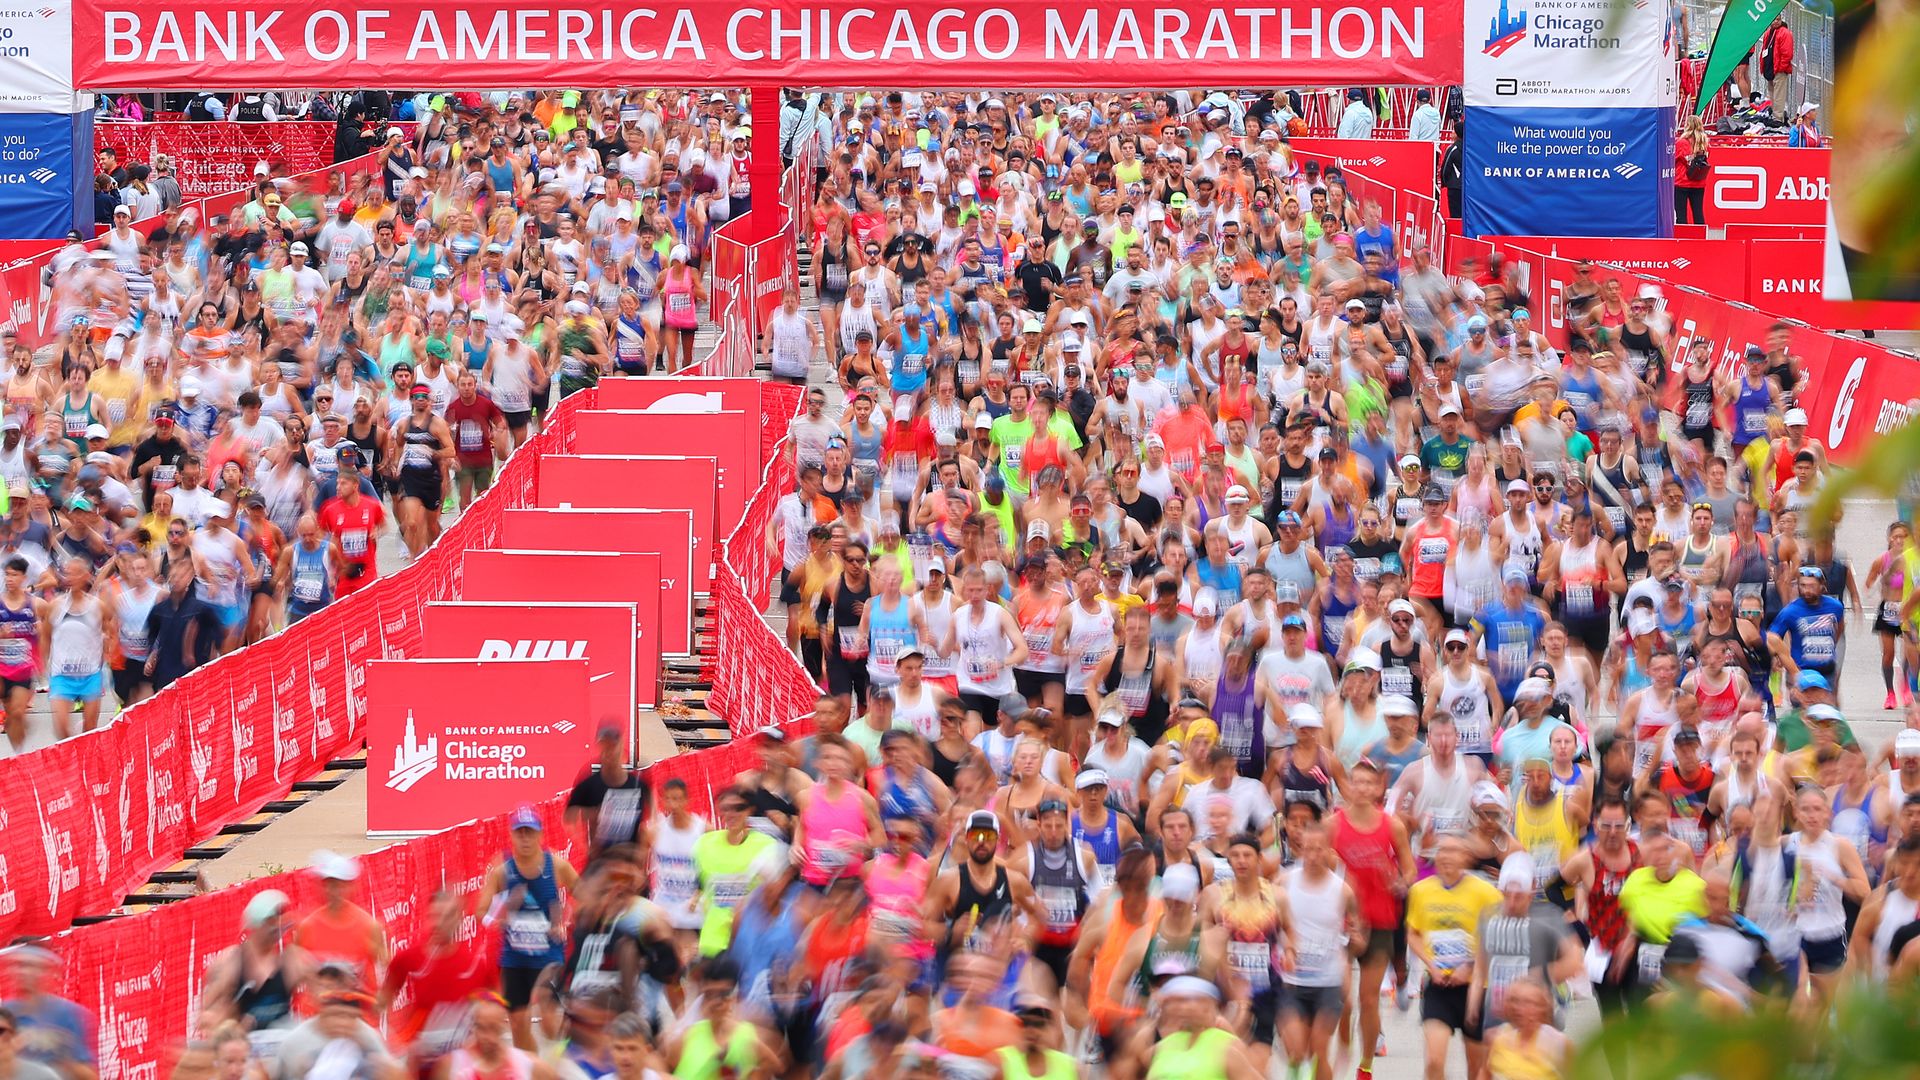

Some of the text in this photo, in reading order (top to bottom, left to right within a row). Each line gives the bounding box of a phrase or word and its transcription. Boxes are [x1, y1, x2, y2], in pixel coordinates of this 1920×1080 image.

[1535, 1, 1562, 9] BANK
[1565, 1, 1578, 9] OF
[1534, 14, 1604, 34] Chicago
[104, 6, 1426, 62] BANK OF AMERICA CHICAGO MARATHON
[1534, 34, 1620, 49] Marathon
[240, 107, 260, 115] POLICE
[4, 135, 25, 147] you
[1514, 126, 1611, 142] What would you
[2, 148, 40, 160] to do?
[1497, 142, 1626, 157] like the power to do?
[182, 160, 246, 177] Chicago
[1484, 167, 1611, 179] BANK OF AMERICA
[1625, 260, 1670, 269] AMERICA
[1762, 279, 1821, 293] BANK
[445, 725, 550, 736] BANK OF AMERICA
[444, 741, 526, 763] Chicago
[445, 763, 545, 780] Marathon
